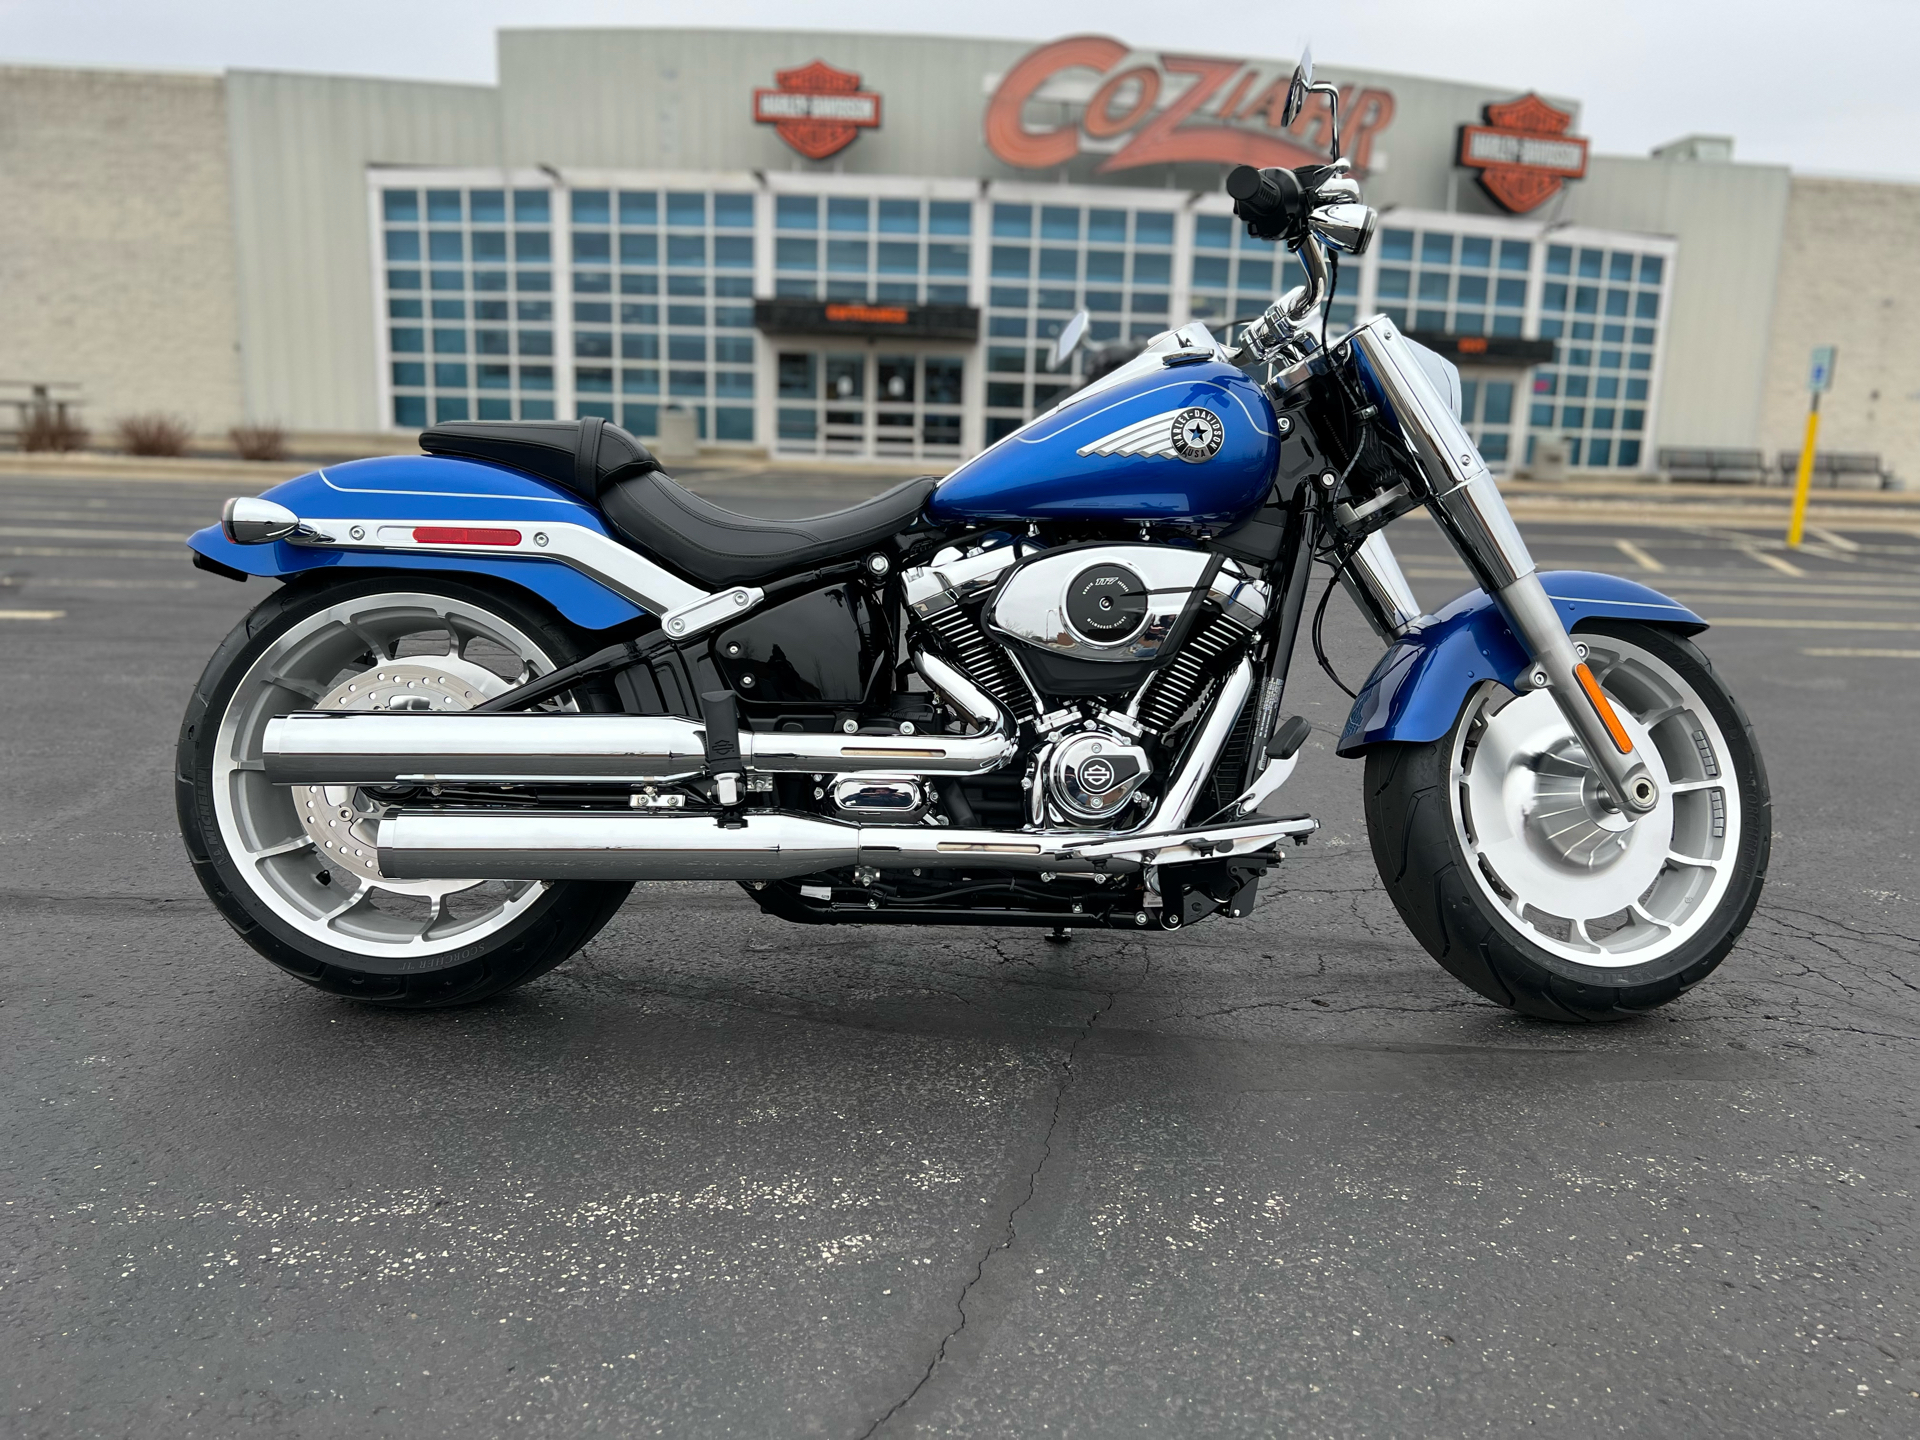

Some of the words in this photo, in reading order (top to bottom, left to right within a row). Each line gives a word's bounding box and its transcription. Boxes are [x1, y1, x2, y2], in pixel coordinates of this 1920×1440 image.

[1173, 409, 1222, 450] HARLEY-DAVIDSON
[1187, 449, 1206, 458] USA
[197, 769, 219, 845] MICHELIN
[1743, 775, 1760, 857] SCORCHER
[419, 942, 485, 969] SCORCHER
